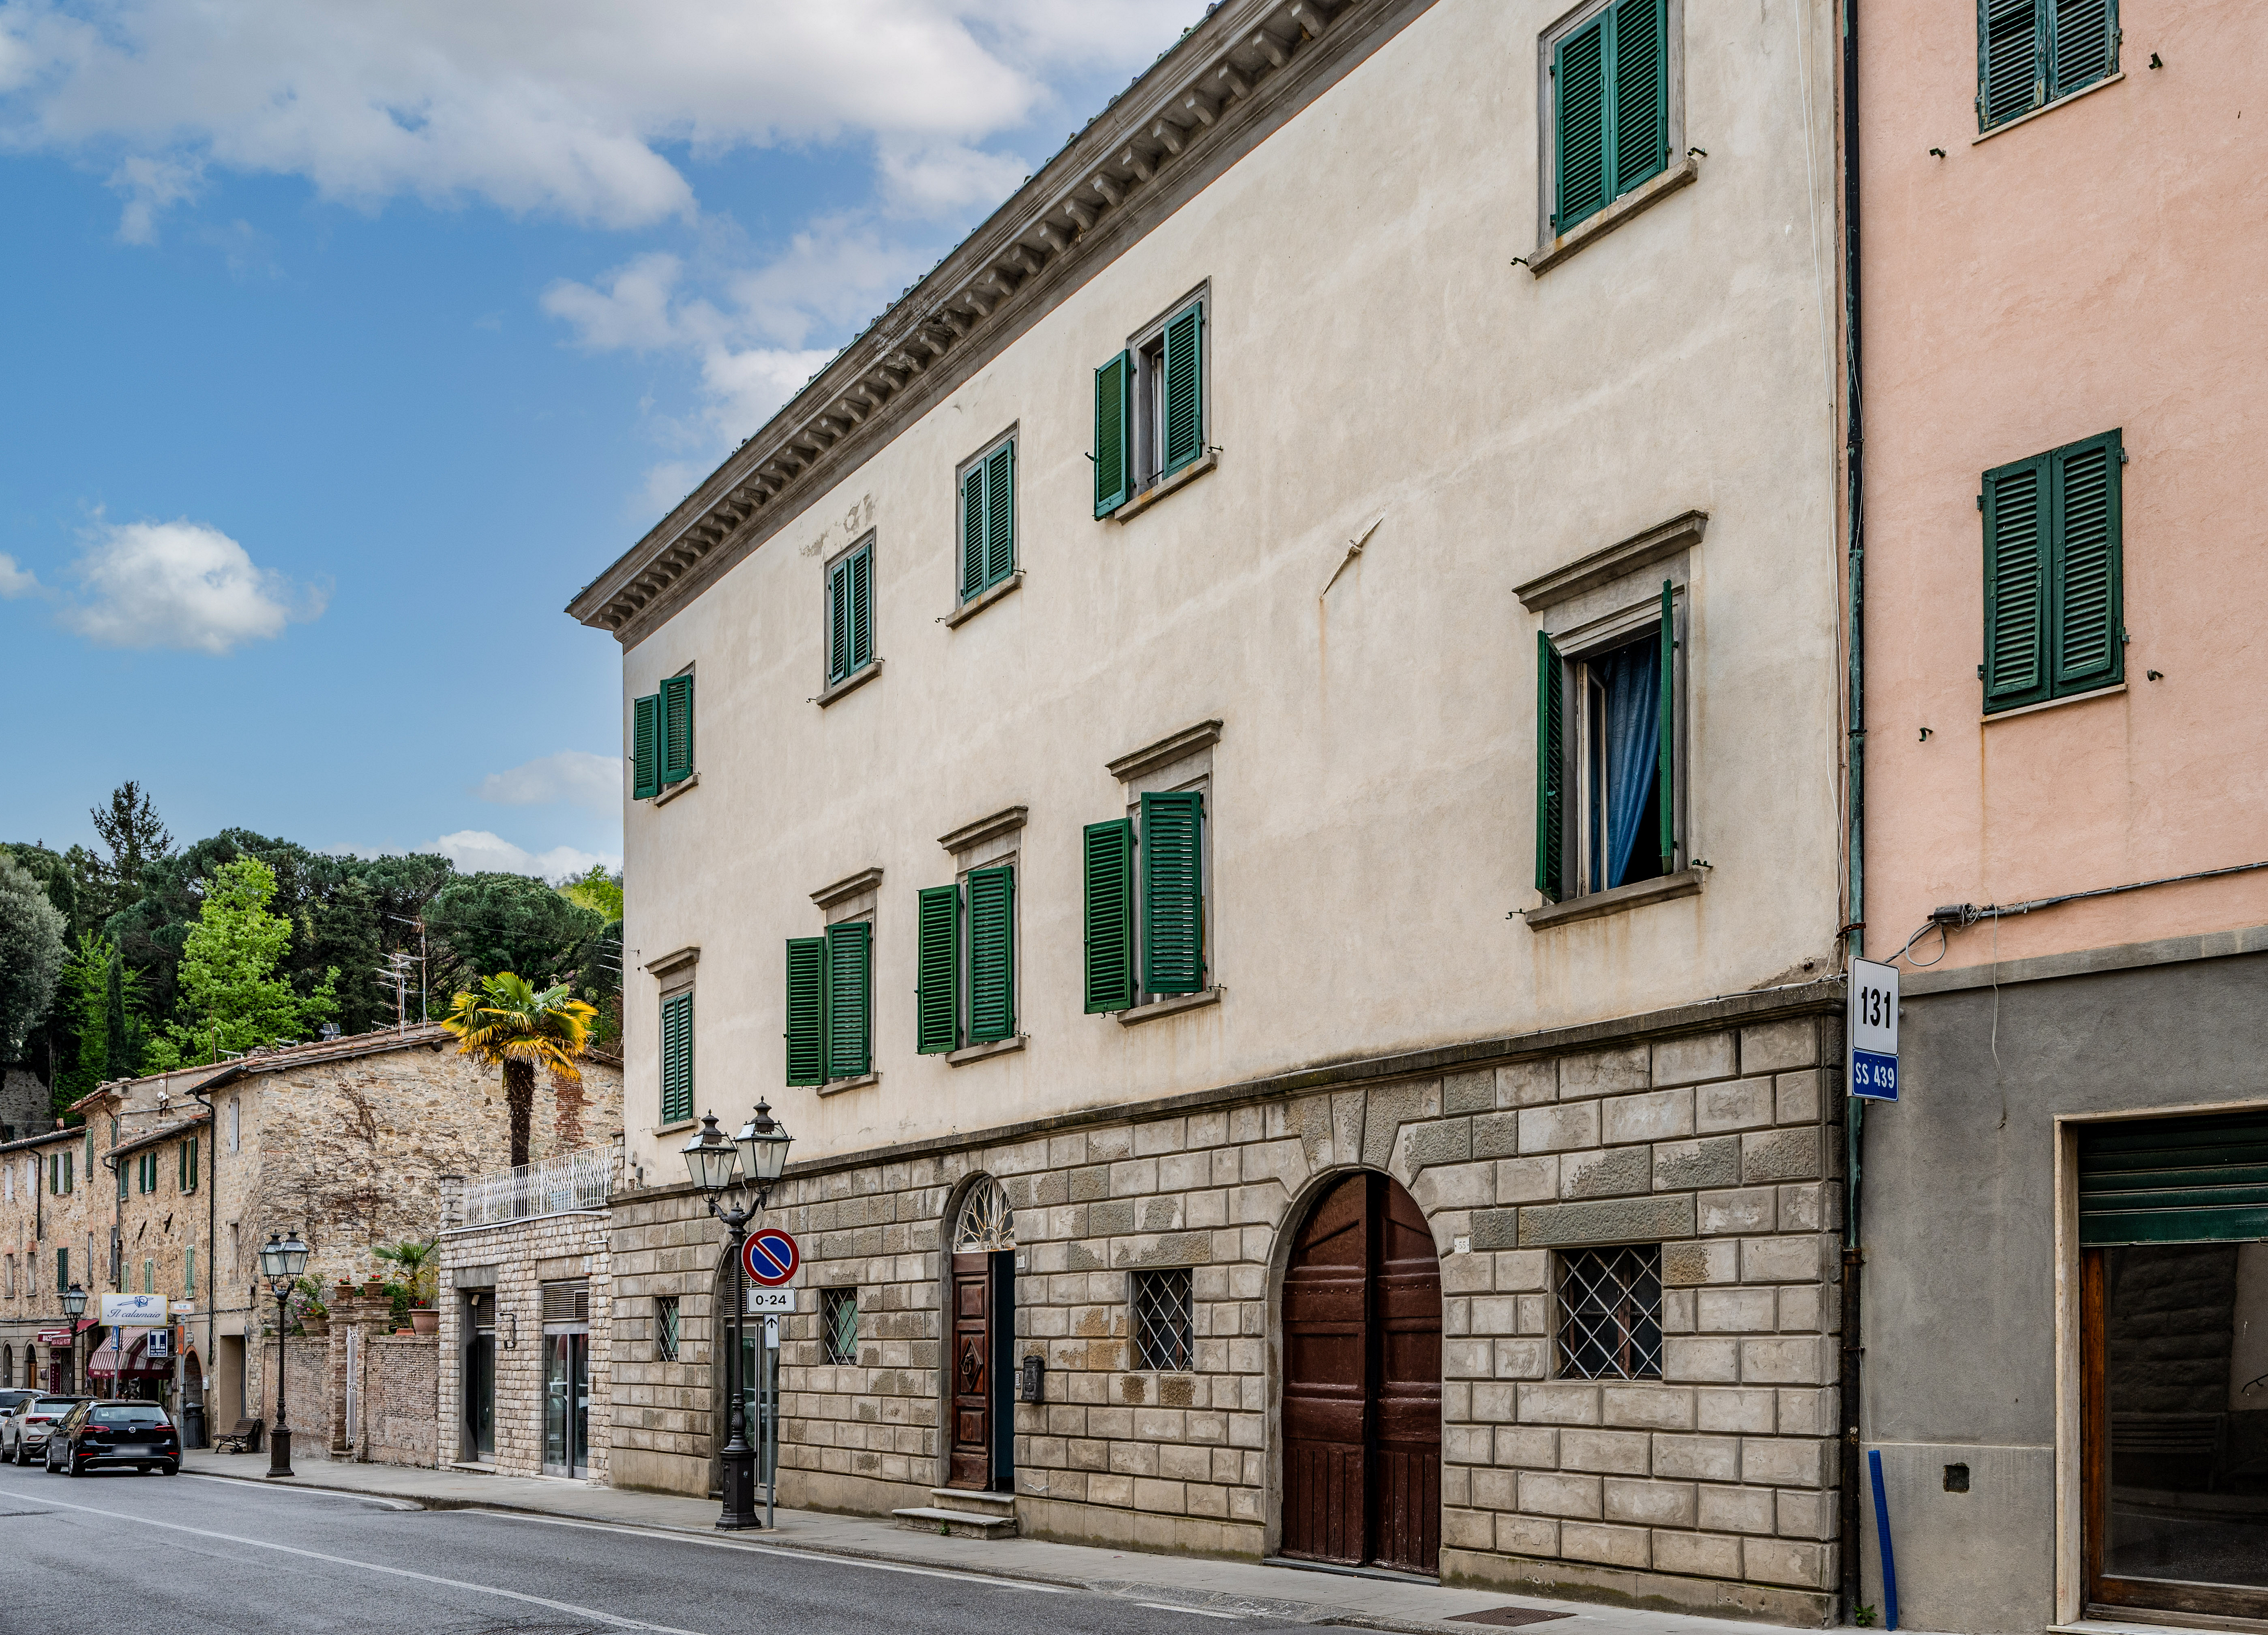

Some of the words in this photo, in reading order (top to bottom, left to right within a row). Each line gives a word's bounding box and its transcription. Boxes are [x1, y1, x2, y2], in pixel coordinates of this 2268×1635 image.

[1861, 986, 1891, 1029] 131
[1855, 1062, 1869, 1085] SS
[1874, 1065, 1895, 1089] 439
[756, 1295, 787, 1305] 0-24
[107, 1309, 121, 1318] Il
[121, 1309, 161, 1318] calamaio
[151, 1331, 165, 1349] T
